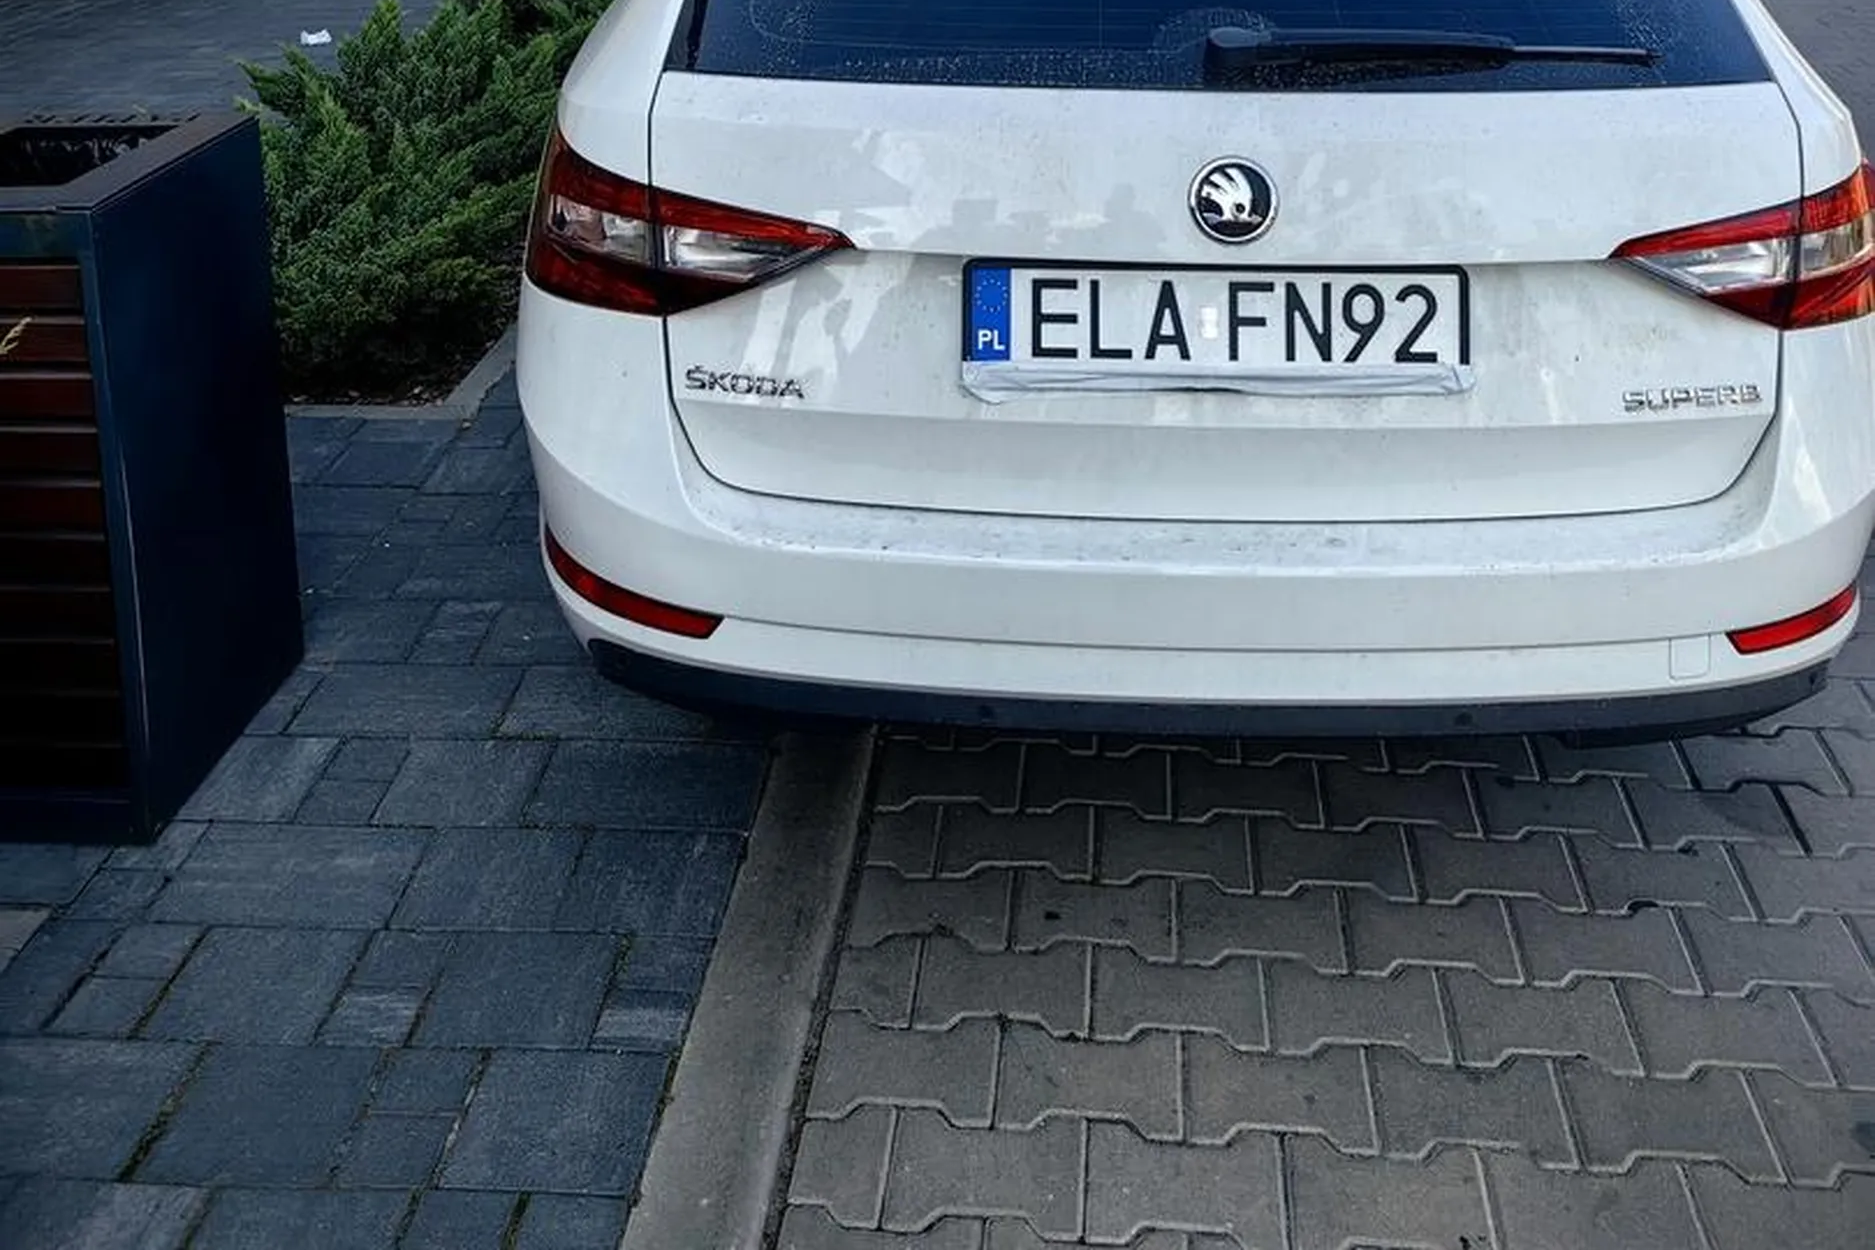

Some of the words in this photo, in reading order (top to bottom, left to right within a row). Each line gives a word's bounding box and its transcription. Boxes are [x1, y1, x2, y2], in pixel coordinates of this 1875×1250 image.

[1032, 278, 1191, 360] ELA
[1227, 281, 1439, 364] FN92
[977, 329, 1006, 350] PL
[1622, 384, 1763, 411] SUPERB
